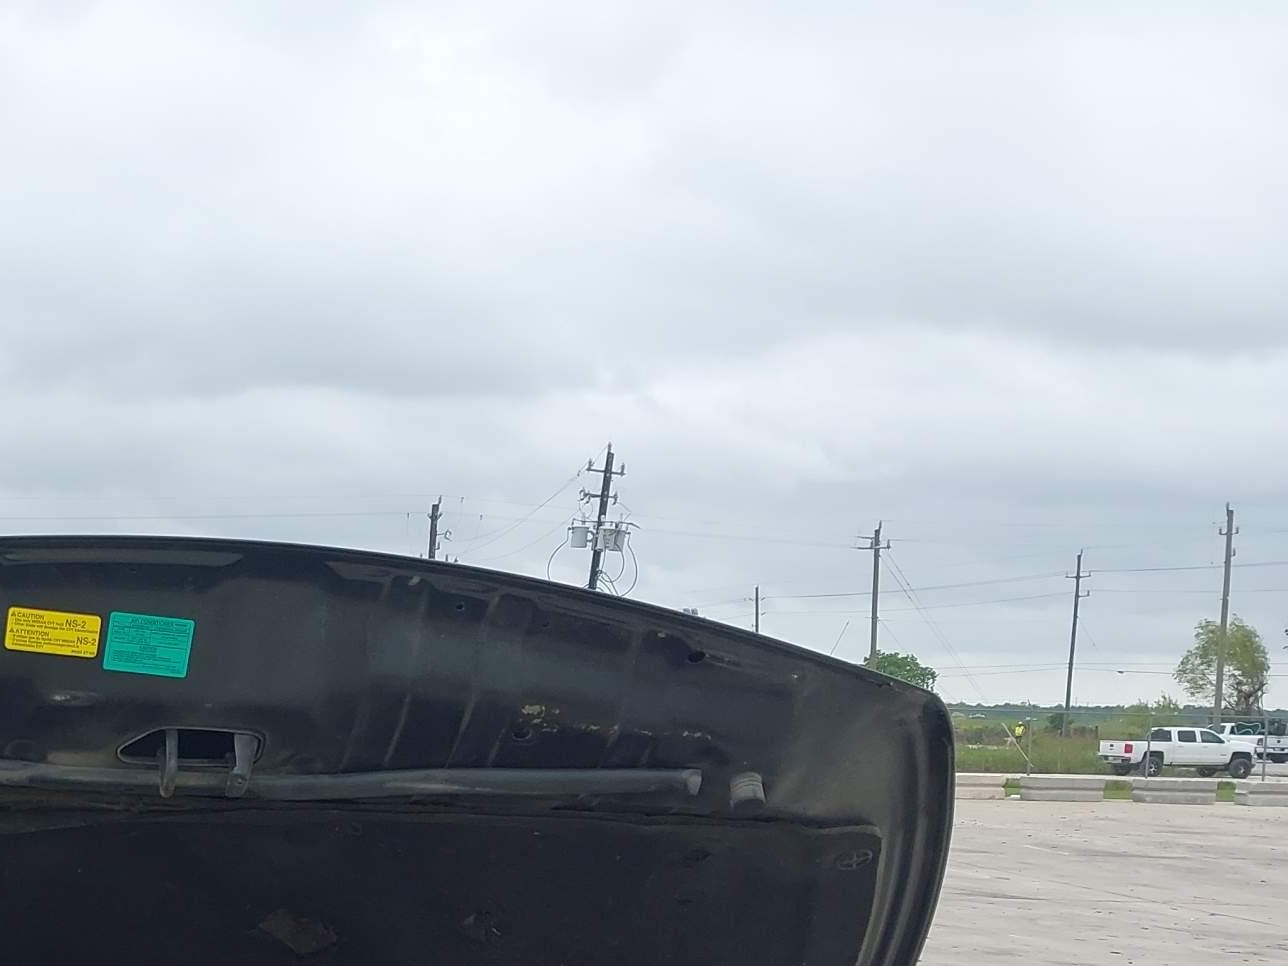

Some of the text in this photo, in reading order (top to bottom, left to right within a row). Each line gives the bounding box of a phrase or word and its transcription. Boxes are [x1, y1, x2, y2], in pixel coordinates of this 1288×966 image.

[17, 612, 44, 620] CAUTION
[65, 618, 87, 629] NS-2
[15, 628, 50, 637] ATTENTION
[76, 636, 96, 646] NS-2
